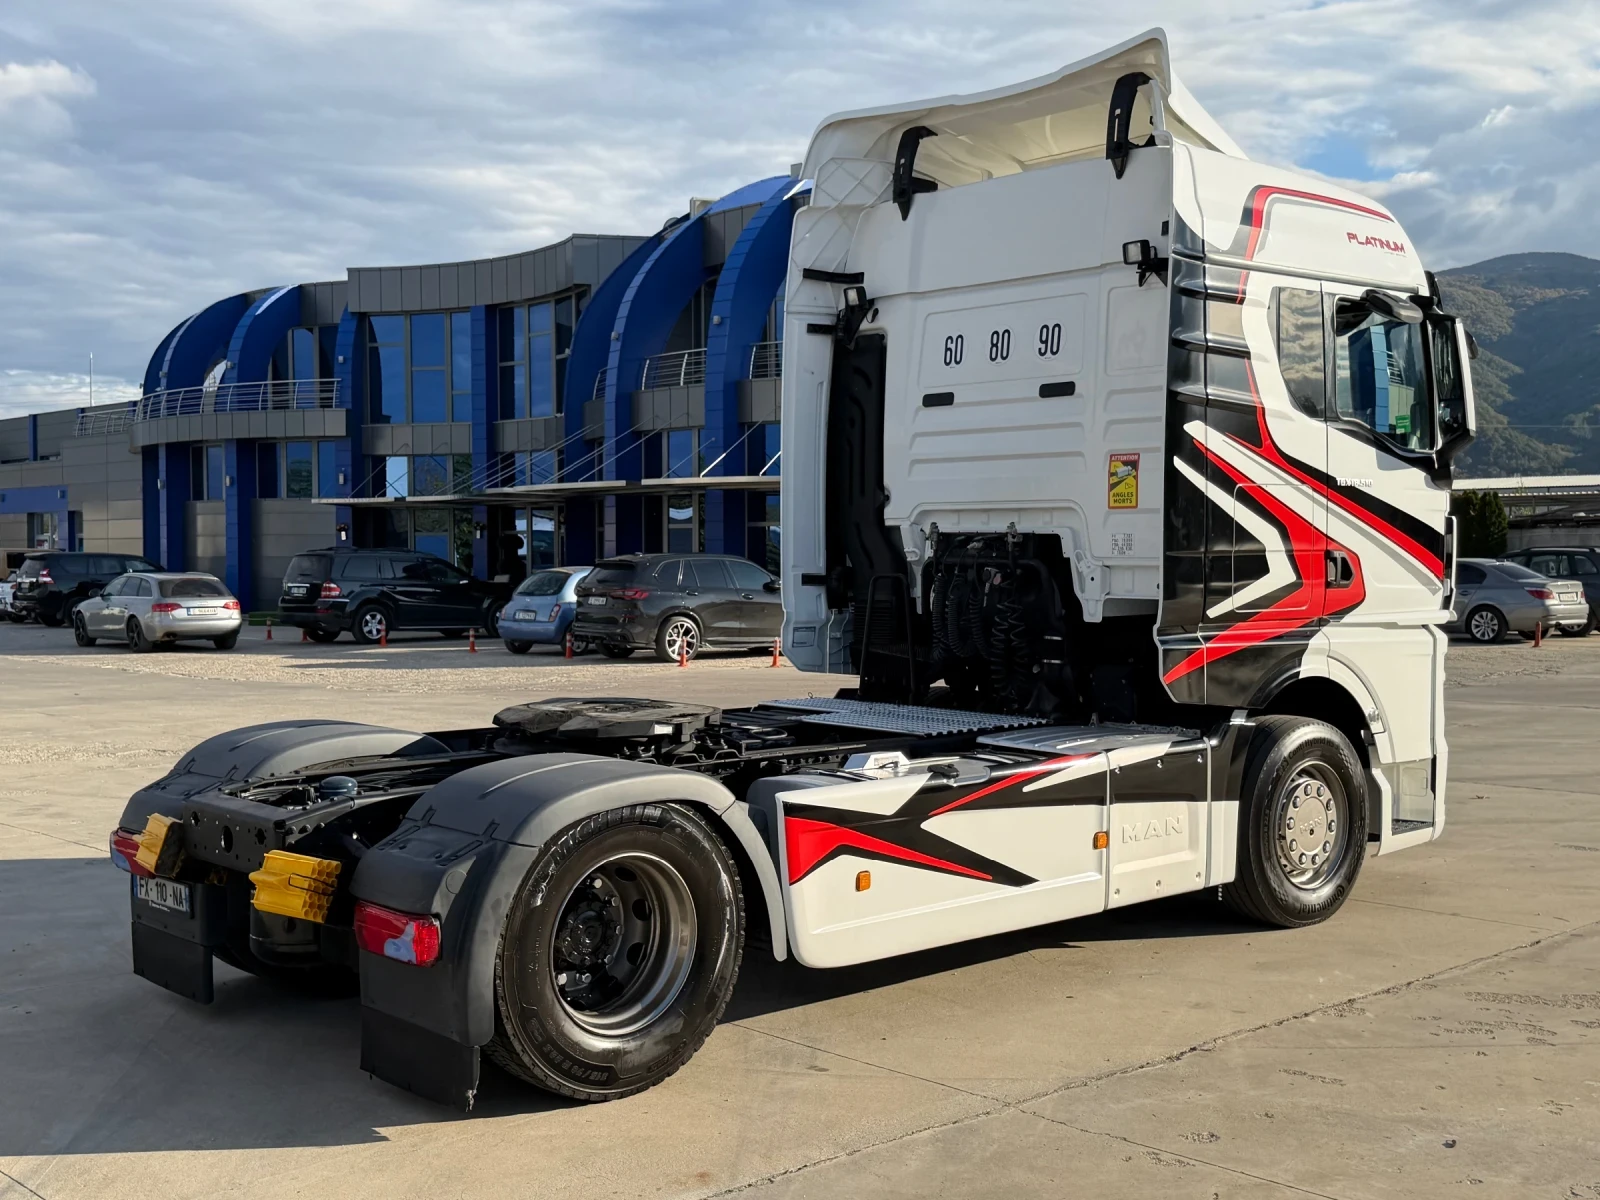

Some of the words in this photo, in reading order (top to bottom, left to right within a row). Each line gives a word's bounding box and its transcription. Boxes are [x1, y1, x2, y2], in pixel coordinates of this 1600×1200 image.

[1347, 231, 1406, 254] PLATINUM
[943, 334, 964, 366] 60
[989, 329, 1011, 362] 80
[1038, 323, 1061, 357] 90
[550, 805, 662, 869] MICHELIN
[1122, 814, 1184, 844] MAN
[1299, 884, 1345, 914] Continental
